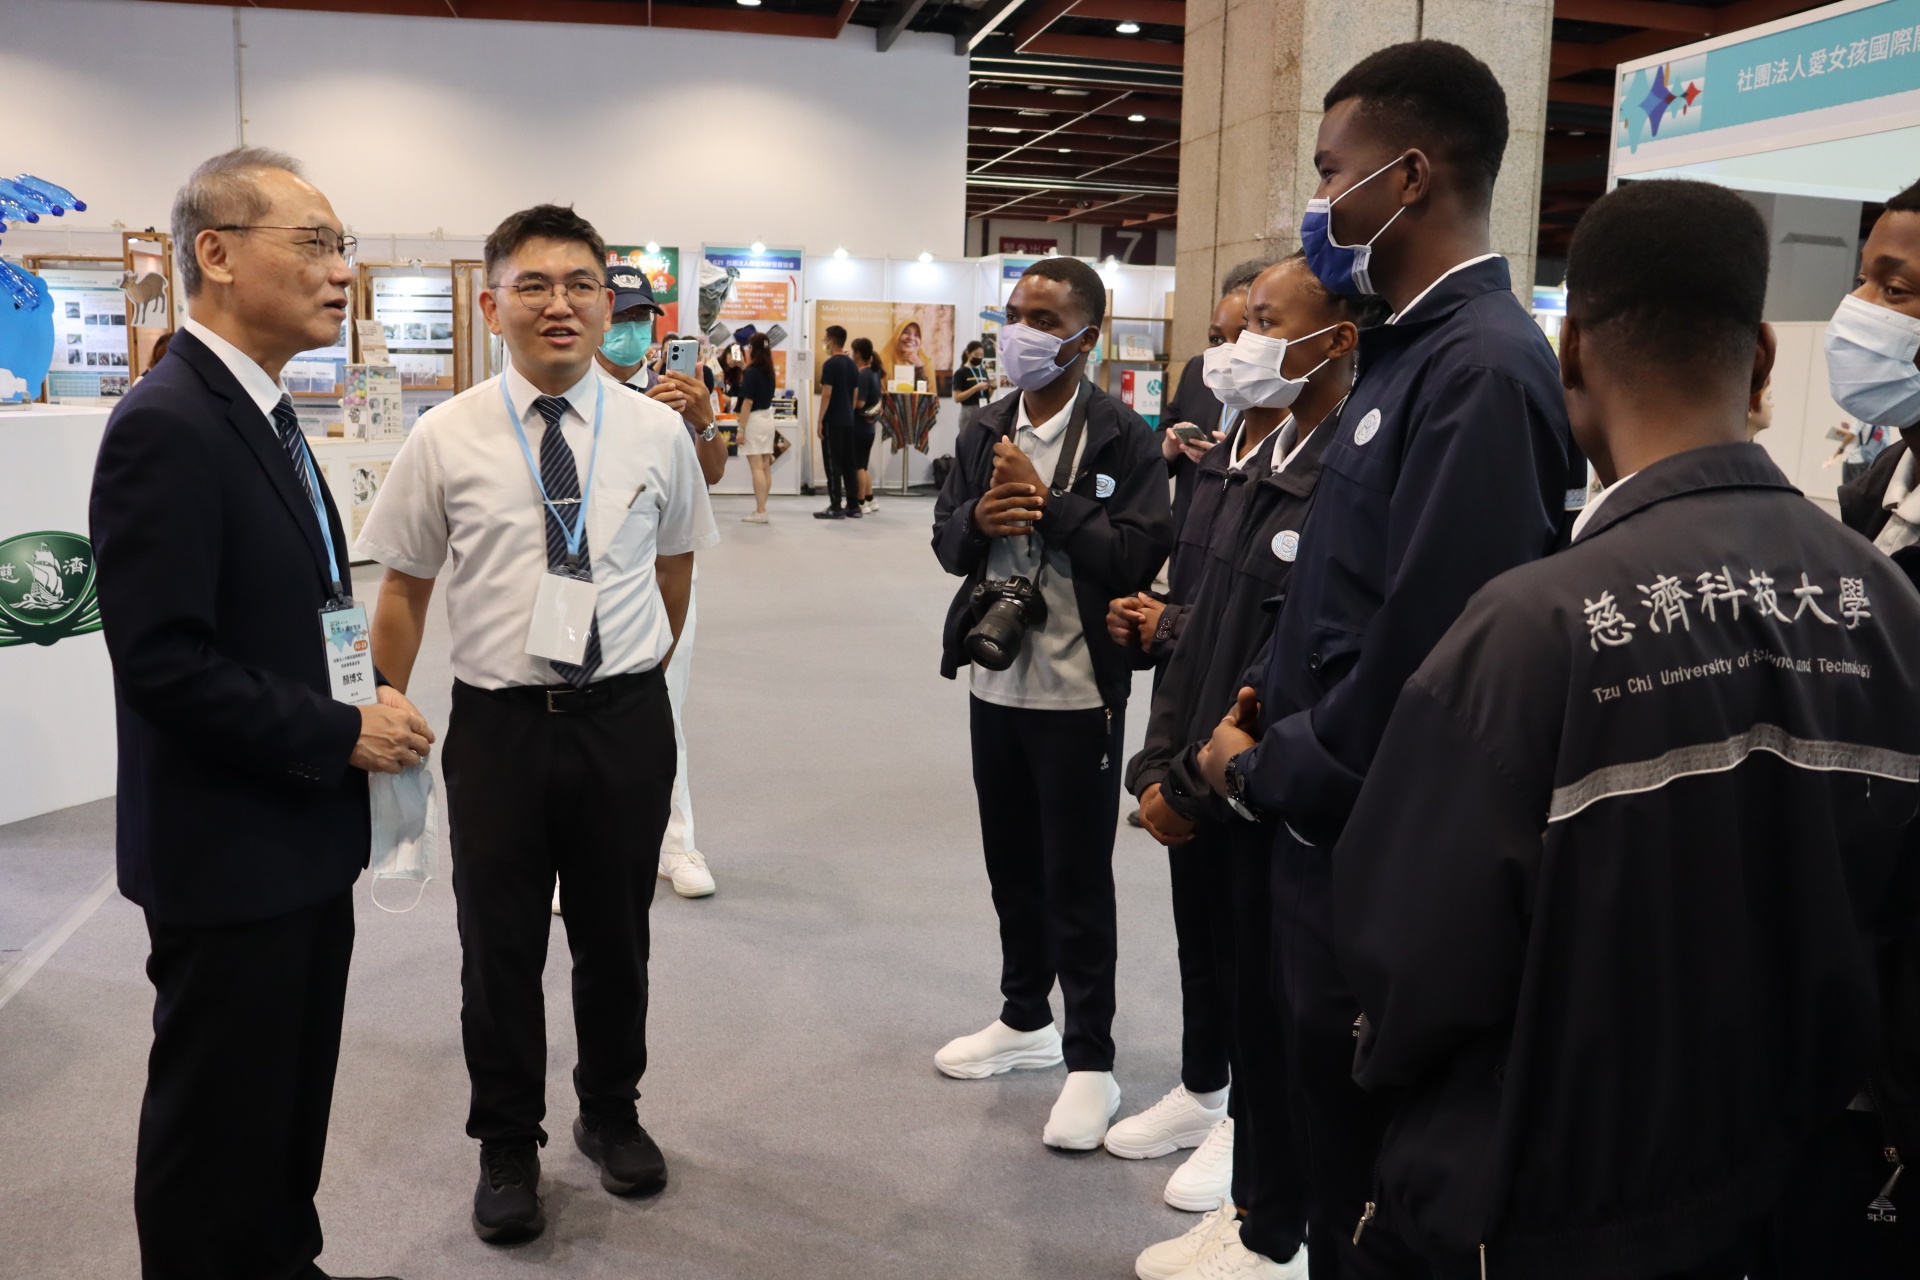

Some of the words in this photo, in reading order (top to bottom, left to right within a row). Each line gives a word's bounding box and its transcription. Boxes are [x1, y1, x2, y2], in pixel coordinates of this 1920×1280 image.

[1116, 231, 1142, 264] 7
[62, 557, 88, 575] 濟
[1583, 565, 1871, 651] 慈濟科技大學
[1592, 686, 1621, 703] Tzu
[1627, 674, 1653, 694] Chi
[1660, 656, 1733, 686] University
[1737, 651, 1750, 668] of
[1796, 657, 1812, 673] and
[1817, 657, 1872, 679] Technology
